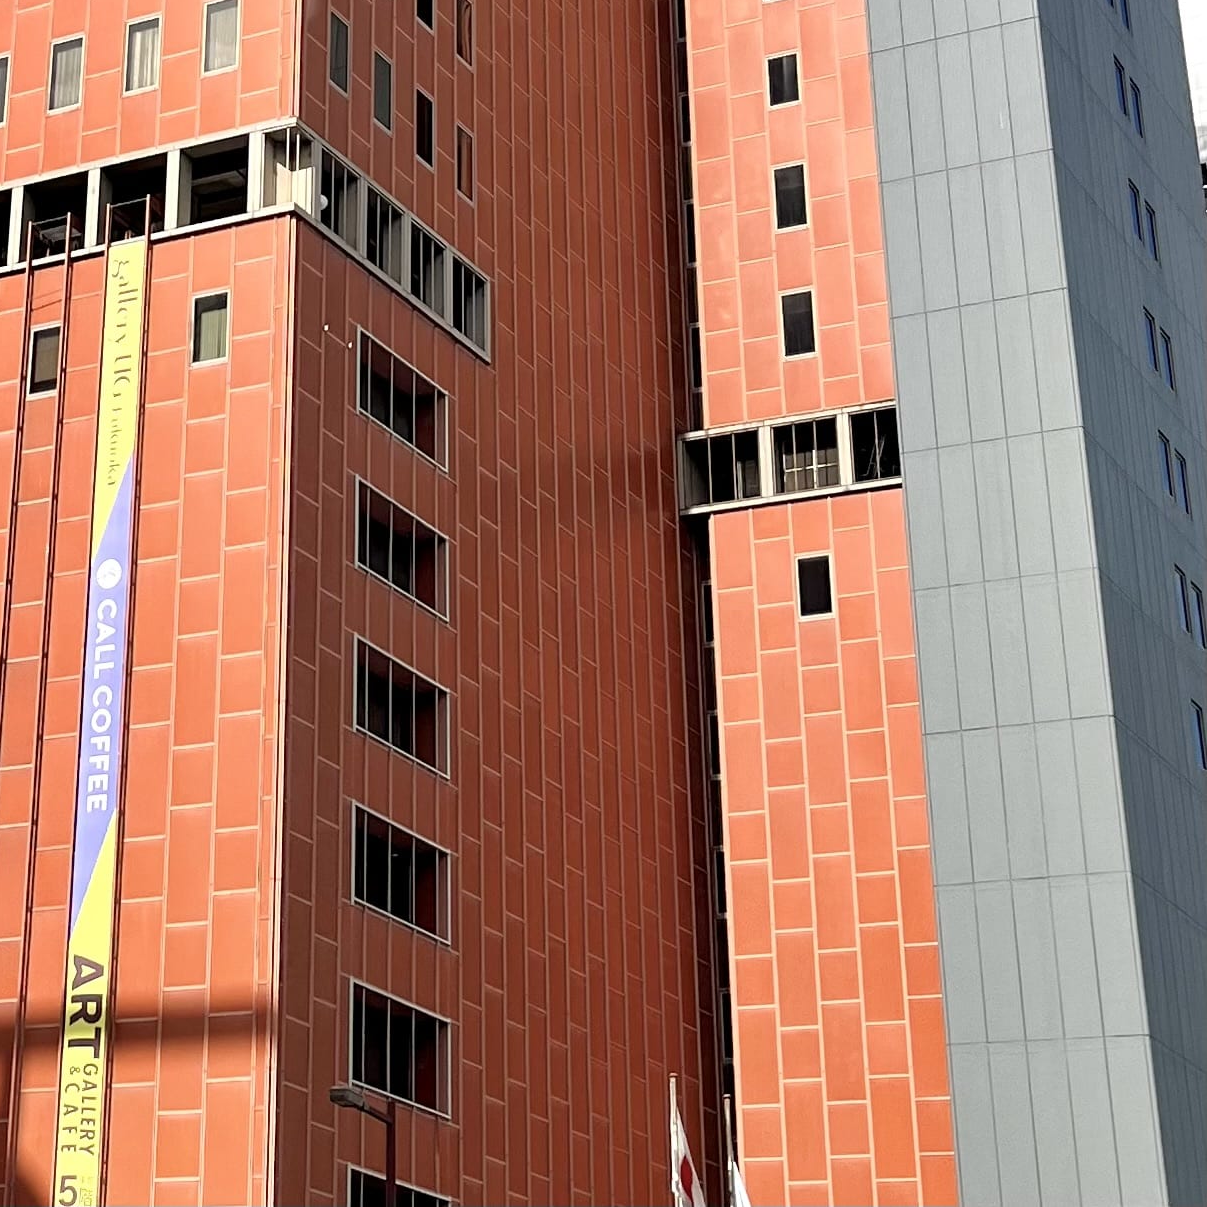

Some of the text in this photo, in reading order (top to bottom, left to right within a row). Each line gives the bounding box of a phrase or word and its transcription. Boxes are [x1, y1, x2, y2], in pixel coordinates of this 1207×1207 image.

[86, 598, 118, 813] CALL COFFEE
[67, 954, 105, 1059] ART
[60, 1082, 80, 1153] CAFE
[78, 1063, 99, 1156] GALLERY
